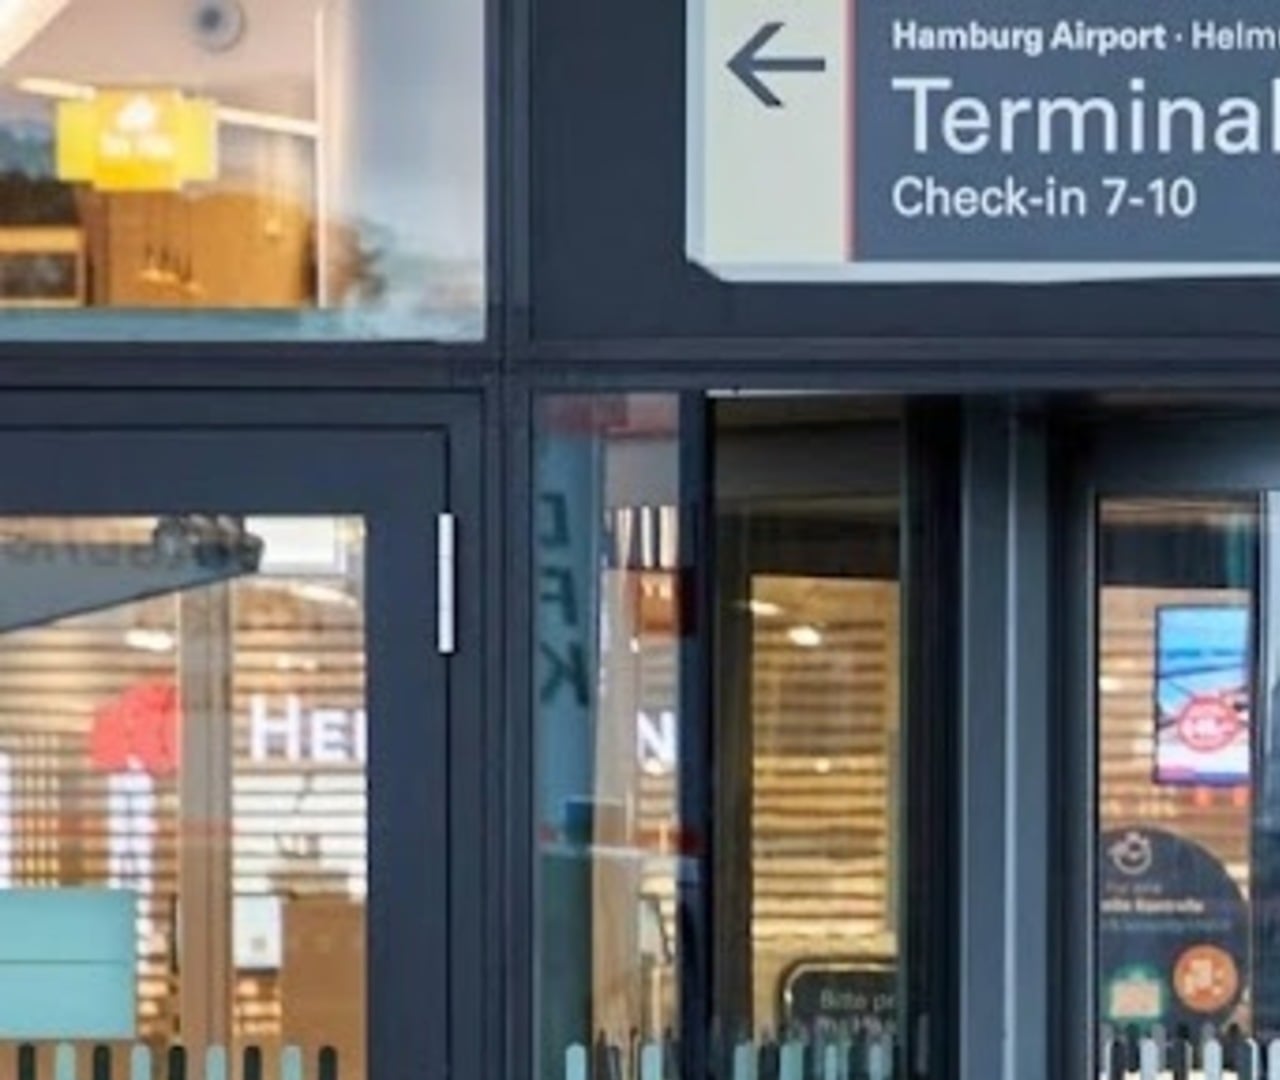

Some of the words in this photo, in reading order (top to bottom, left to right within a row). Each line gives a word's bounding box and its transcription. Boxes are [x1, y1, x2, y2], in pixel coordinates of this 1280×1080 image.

[892, 19, 1045, 58] Hamburg
[1049, 19, 1168, 57] Airport
[891, 174, 1087, 218] Check-in
[1101, 175, 1198, 218] 7-10
